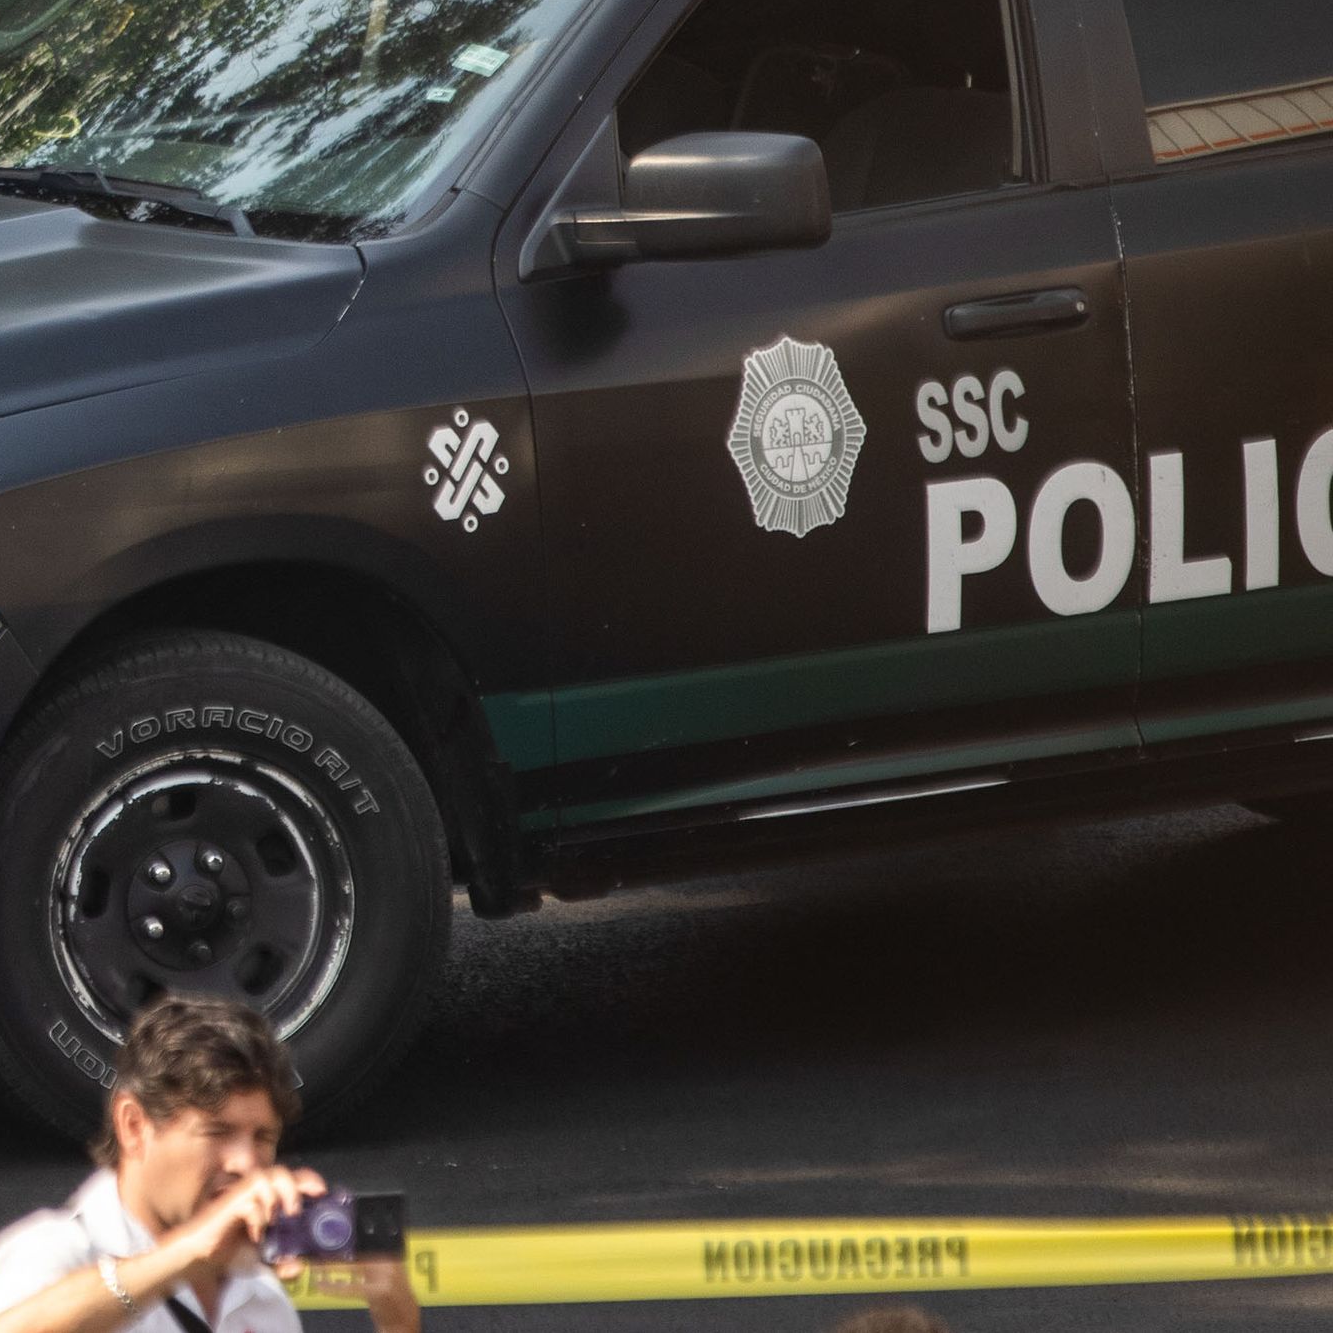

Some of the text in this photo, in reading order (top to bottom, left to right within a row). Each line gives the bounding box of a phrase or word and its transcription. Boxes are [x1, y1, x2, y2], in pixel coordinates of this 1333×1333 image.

[753, 384, 842, 437] SEGURIDAD CIUDADANA
[916, 371, 1029, 462] SSC
[760, 464, 790, 493] CIUDAD
[793, 483, 807, 494] DE
[96, 706, 380, 815] VORACIO A/T
